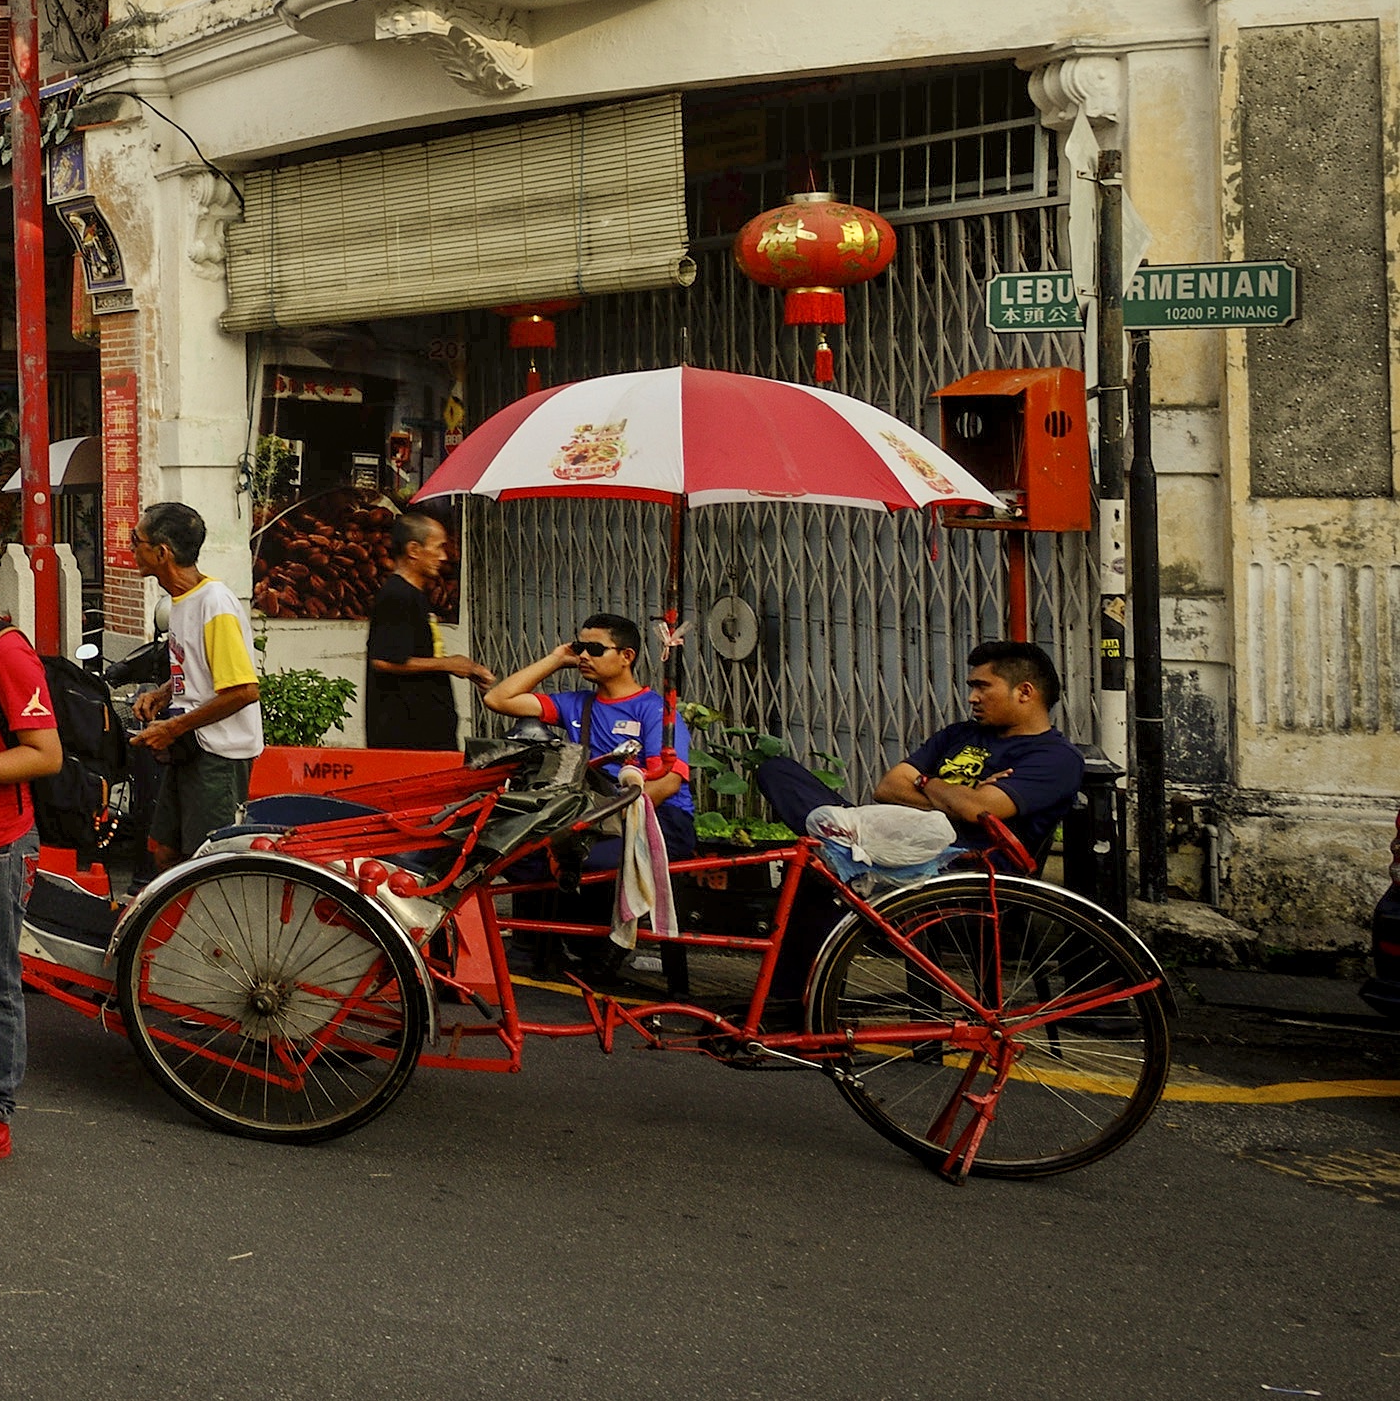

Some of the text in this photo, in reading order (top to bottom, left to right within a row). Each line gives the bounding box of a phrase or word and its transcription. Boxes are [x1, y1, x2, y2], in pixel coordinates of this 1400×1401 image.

[1000, 269, 1280, 306] LEBU RMENIAN
[1165, 304, 1279, 321] 10200 P. PINANG
[304, 762, 353, 780] MPPP
